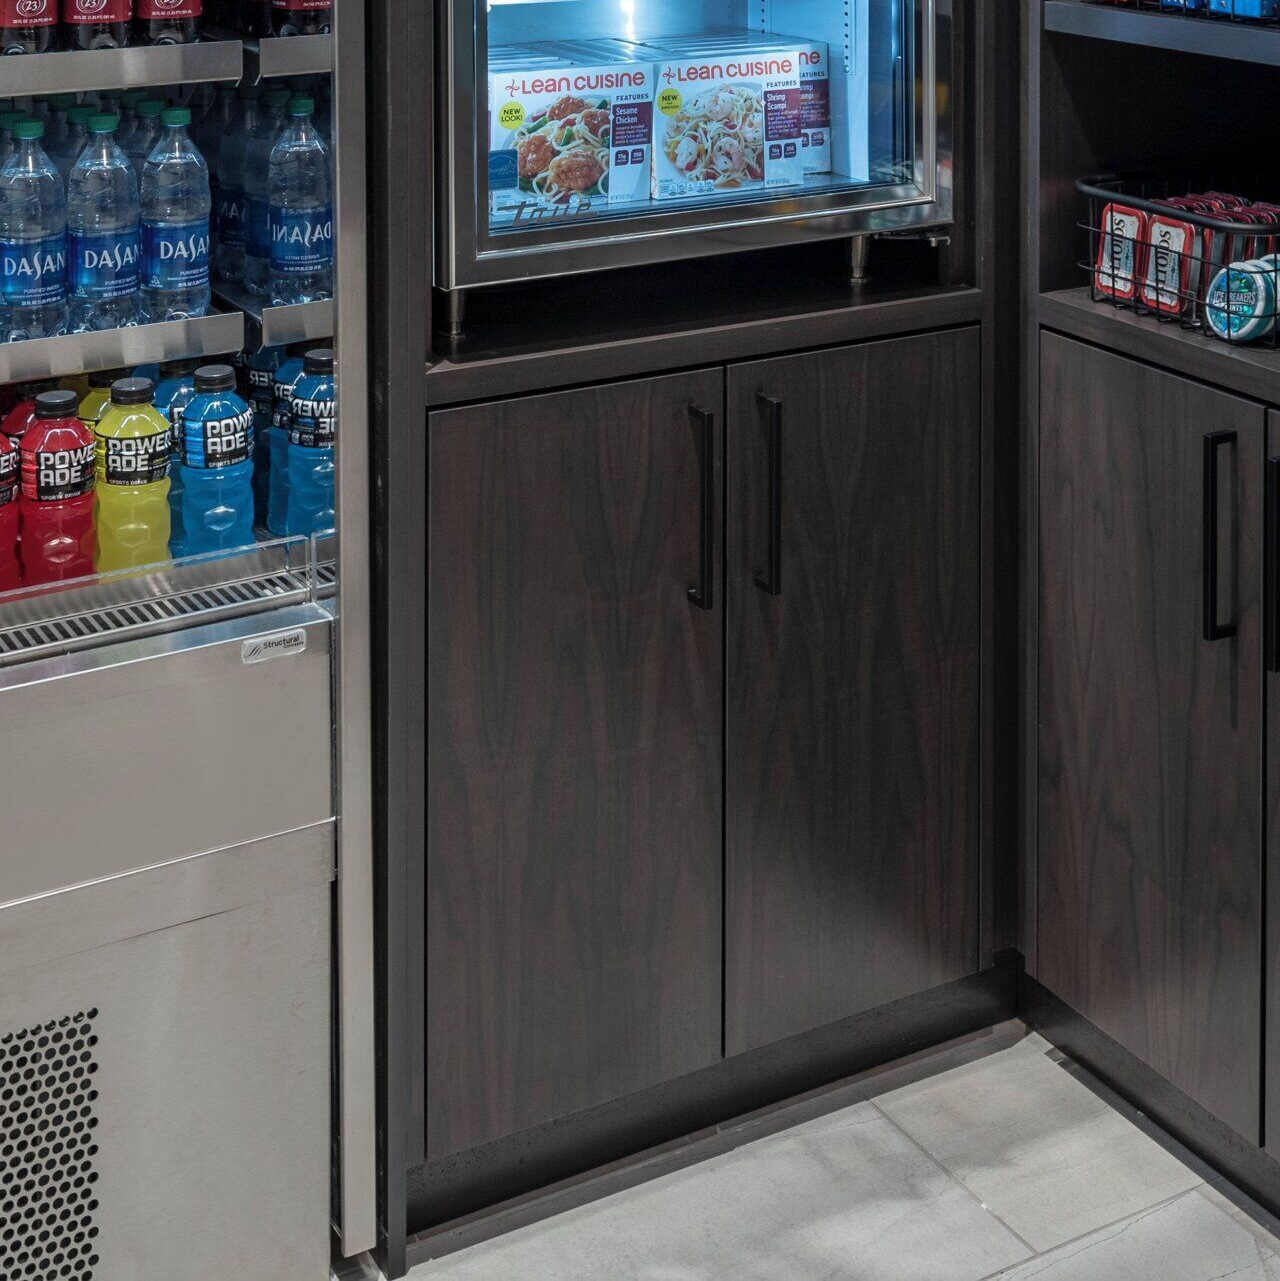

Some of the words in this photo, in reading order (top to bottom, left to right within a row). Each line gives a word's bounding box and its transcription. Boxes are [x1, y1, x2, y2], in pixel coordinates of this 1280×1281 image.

[26, 0, 38, 11] 23
[677, 64, 723, 81] Lean
[522, 77, 570, 95] Lean
[766, 80, 797, 88] FEATURES
[767, 94, 786, 102] Shrimp
[616, 107, 638, 115] Sesame
[768, 103, 786, 111] Scampi
[616, 116, 638, 124] Chicken
[1213, 291, 1223, 304] ICE
[207, 432, 245, 454] ADE
[40, 442, 96, 469] POWE
[40, 469, 81, 487] ADE
[263, 635, 299, 649] Structural
